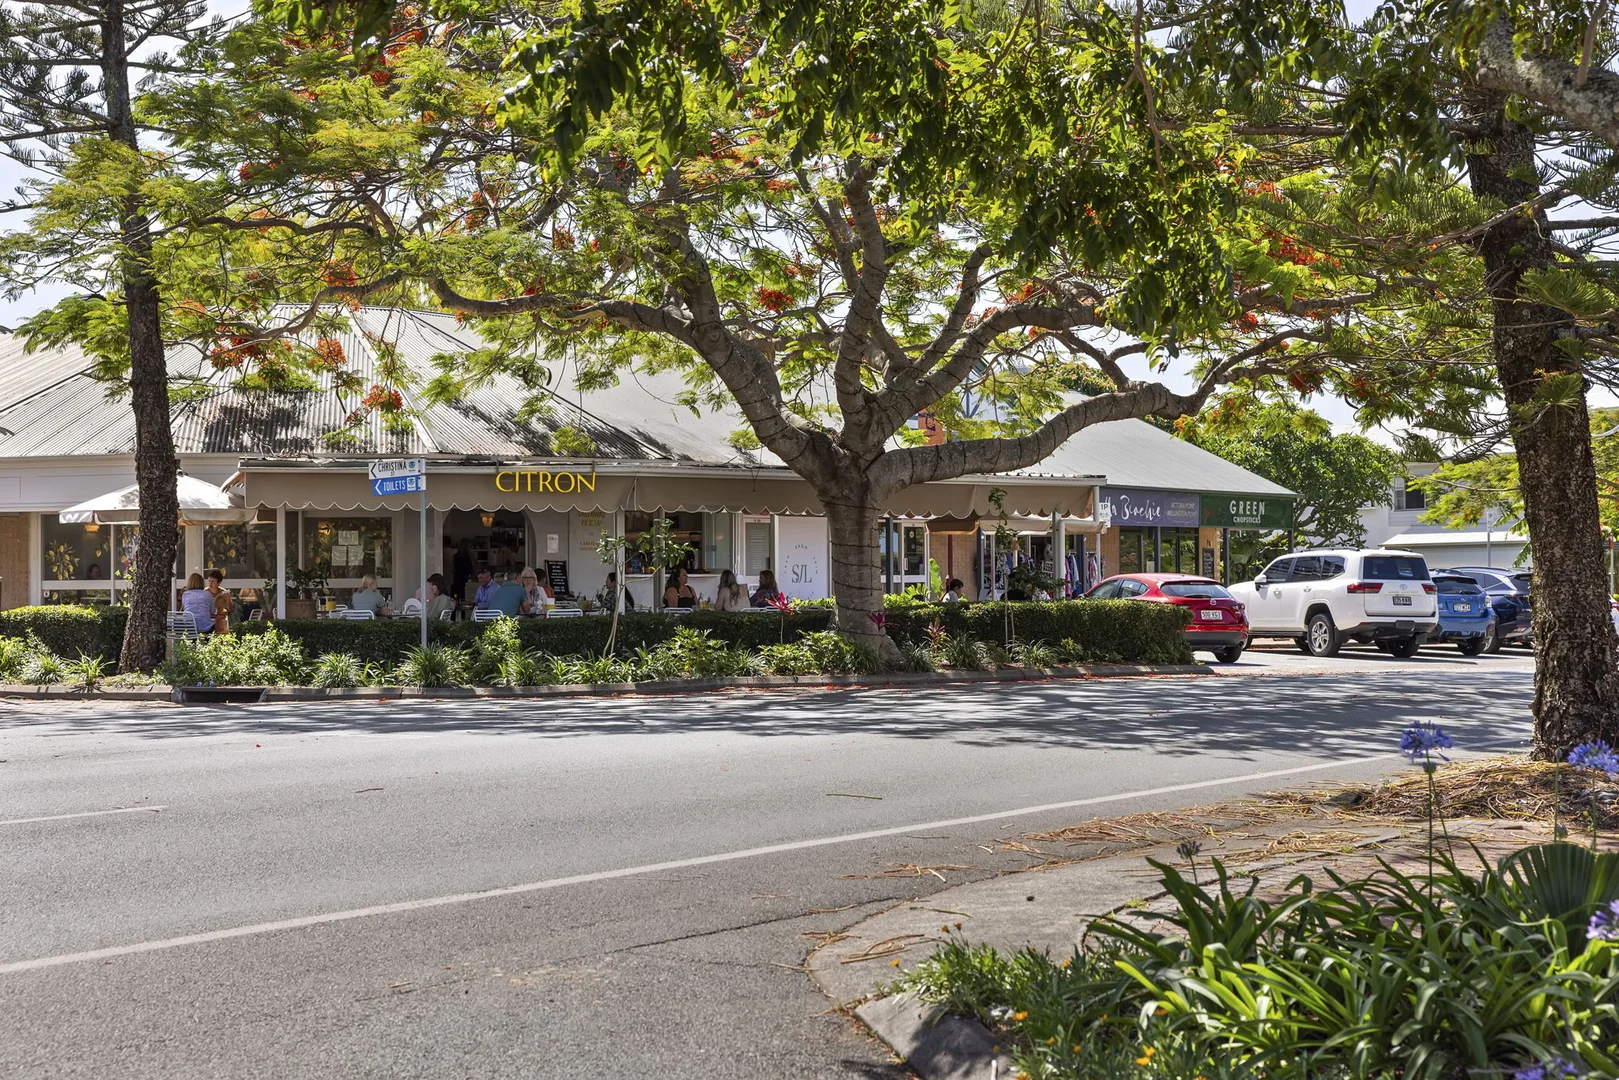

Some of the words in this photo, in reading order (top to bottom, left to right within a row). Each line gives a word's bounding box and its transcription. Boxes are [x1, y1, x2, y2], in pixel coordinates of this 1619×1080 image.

[378, 461, 407, 472] CHRISTINA
[383, 480, 406, 491] TOILETS
[495, 470, 596, 493] CITRON
[1230, 500, 1265, 515] GREEN
